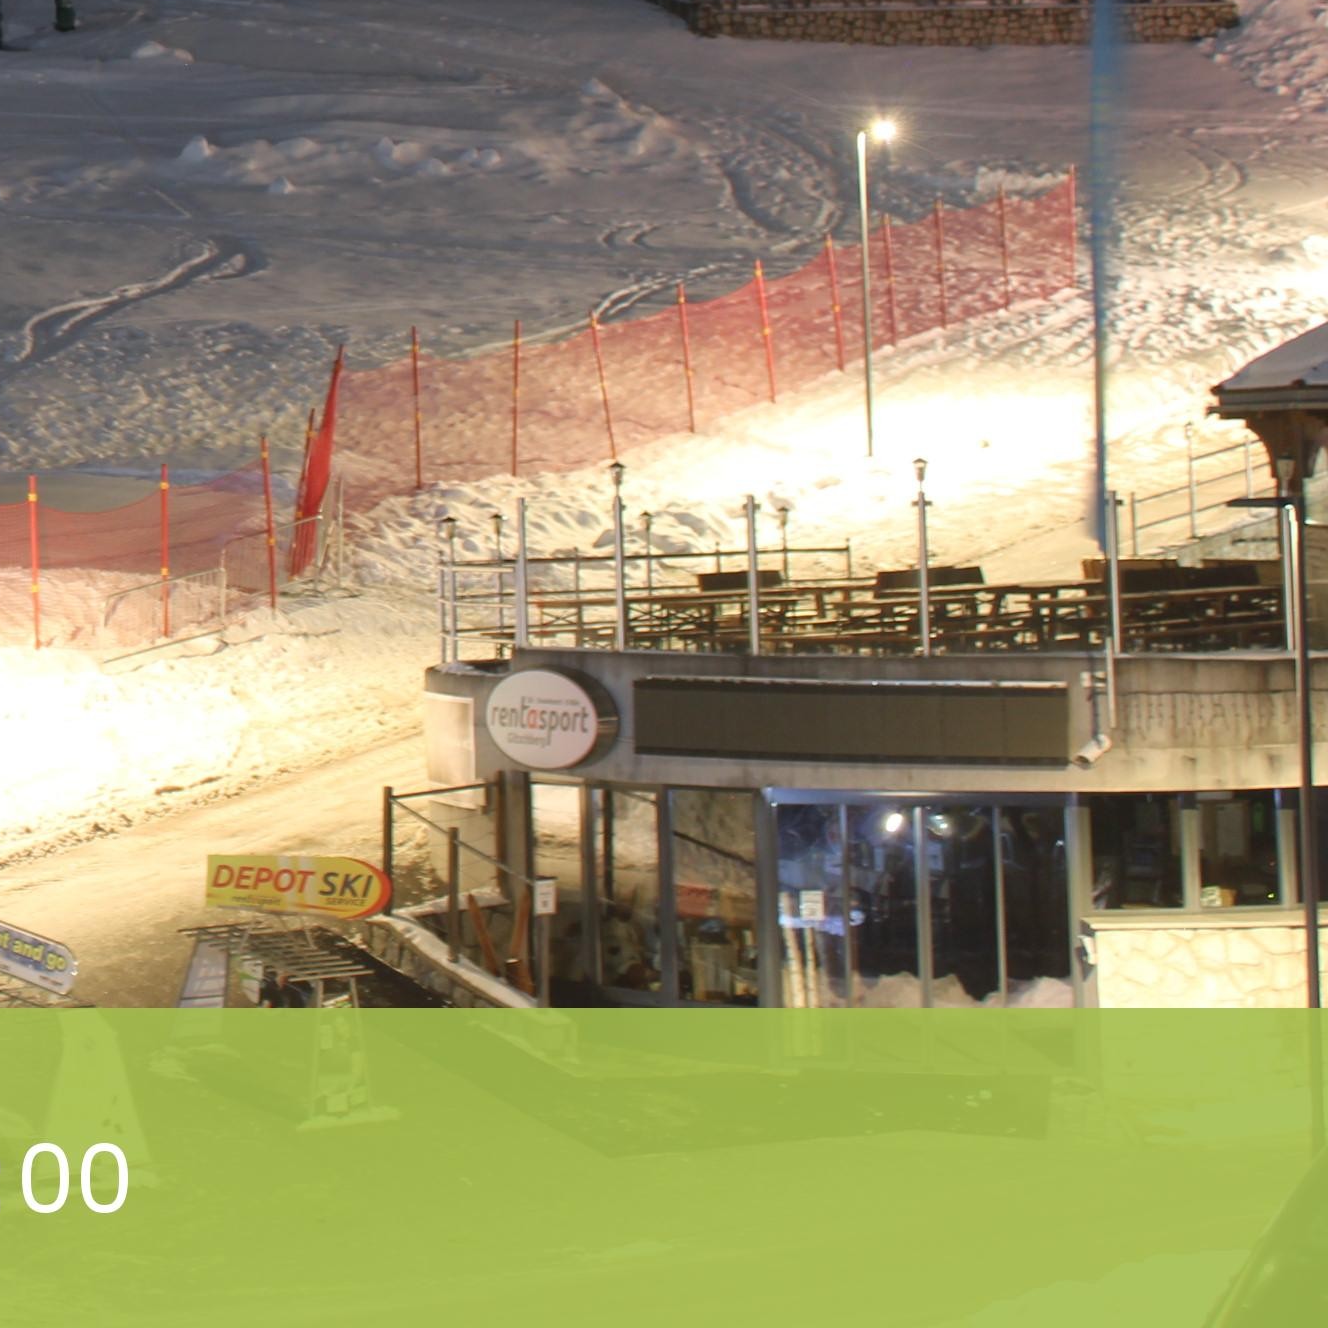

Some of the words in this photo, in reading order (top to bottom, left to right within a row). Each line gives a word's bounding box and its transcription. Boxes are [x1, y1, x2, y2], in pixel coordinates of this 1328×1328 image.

[212, 864, 317, 894] DEPOT
[319, 872, 374, 899] SKI
[11, 939, 44, 962] and
[46, 952, 66, 971] go
